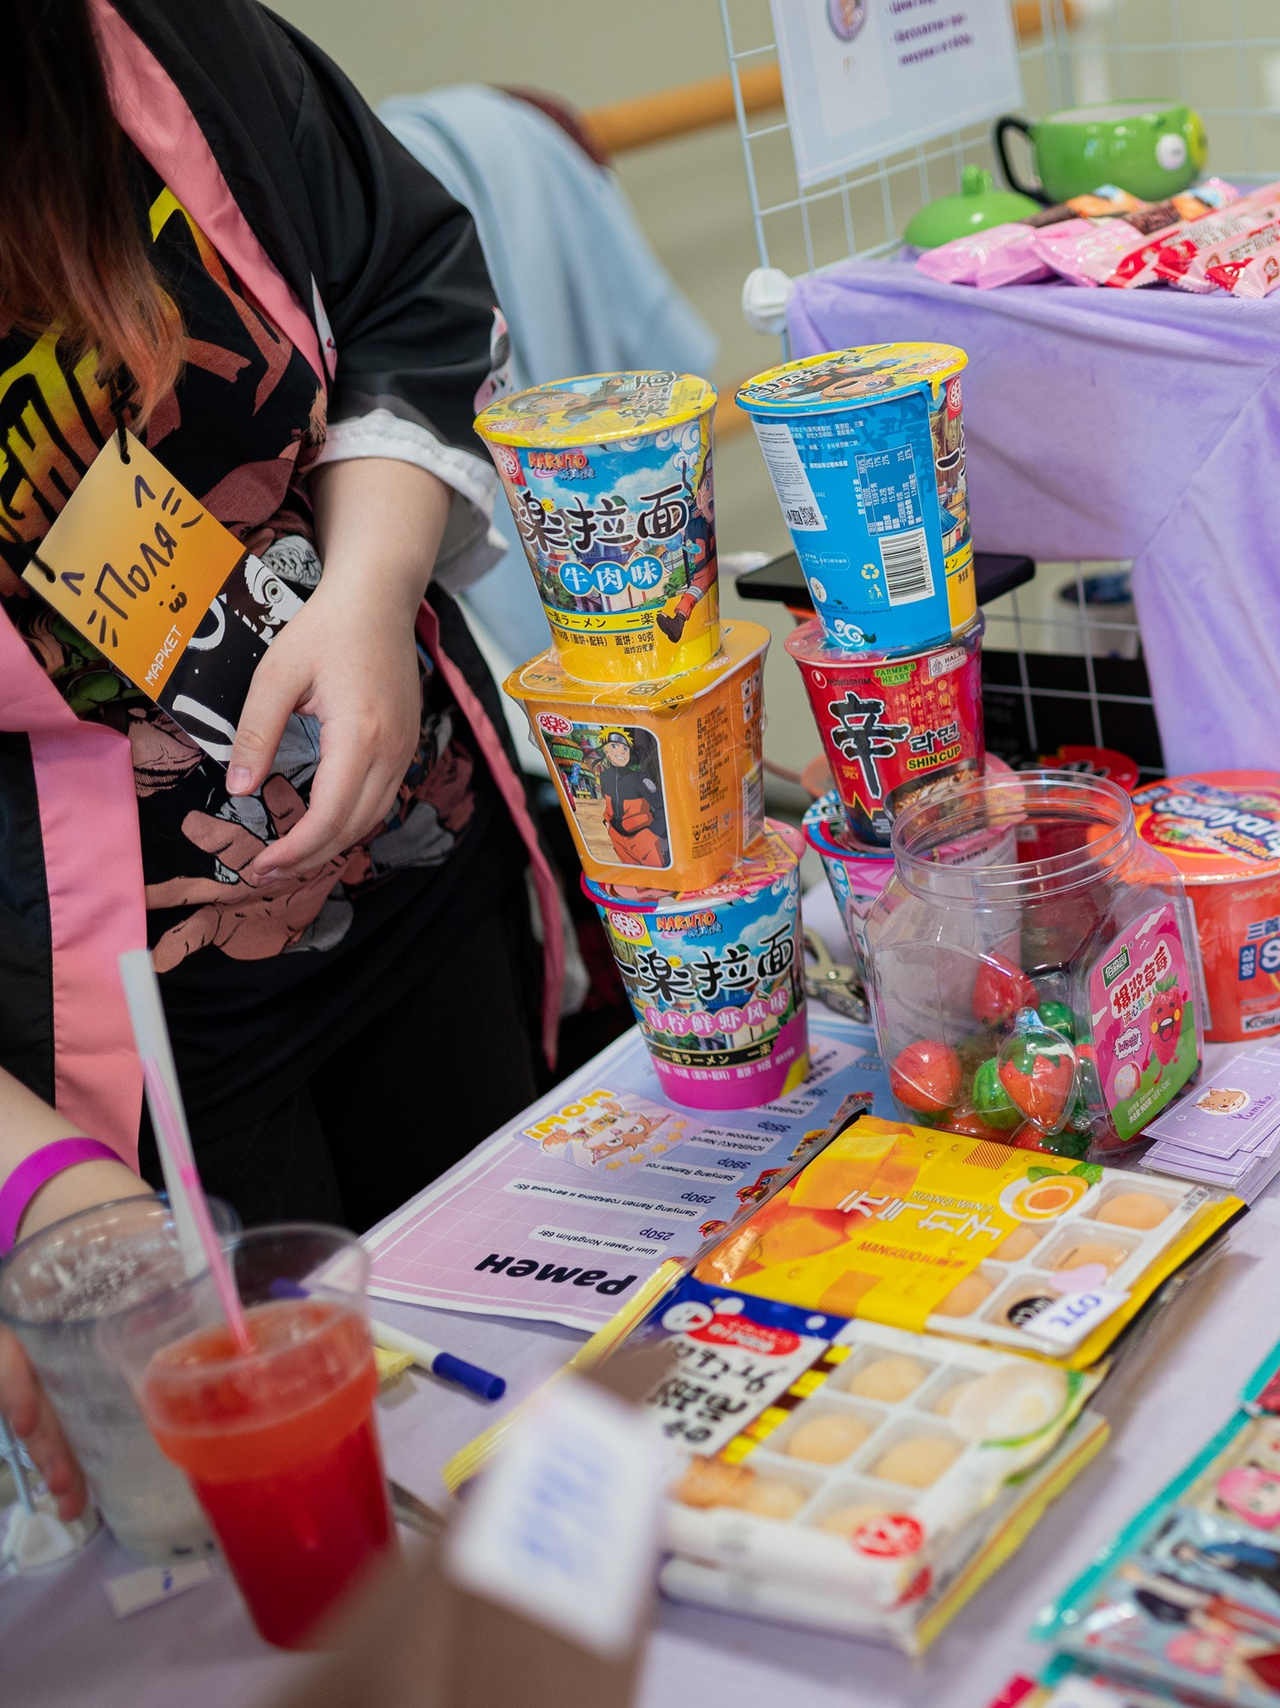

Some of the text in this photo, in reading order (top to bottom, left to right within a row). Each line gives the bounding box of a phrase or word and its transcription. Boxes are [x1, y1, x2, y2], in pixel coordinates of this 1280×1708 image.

[528, 451, 588, 472] NARUTO
[562, 559, 662, 592] 牛肉味
[144, 623, 184, 687] МАРКЕТ
[944, 650, 966, 664] HALAL
[874, 663, 917, 678] FARMER'S
[881, 672, 911, 684] HEART
[826, 677, 872, 687] NONGSHIM
[827, 690, 912, 800] 辛
[909, 721, 961, 754] 라면
[908, 745, 962, 770] SHIN CUP
[656, 911, 717, 932] NARUTO
[1111, 945, 1169, 1015] 爆浆草莓
[523, 1086, 616, 1138] WOW!
[1233, 1093, 1273, 1121] Yumiko
[689, 1134, 766, 1152] ICHIRAKU Narut
[662, 1164, 692, 1176] Ramen
[717, 1157, 752, 1171] 390р
[693, 1168, 737, 1182] Samyang
[531, 1185, 568, 1199] ветчина
[577, 1192, 621, 1207] говядина
[680, 1191, 716, 1205] 290р
[909, 1189, 954, 1205] YUANQI
[622, 1199, 654, 1212] Ramen
[655, 1202, 698, 1217] Samyang
[556, 1231, 603, 1248] Nongshim
[638, 1226, 676, 1242] 250р
[603, 1239, 634, 1253] Рамен
[635, 1245, 659, 1257] Шин
[857, 1240, 922, 1264] MANGGUO
[474, 1252, 638, 1297] Рамен
